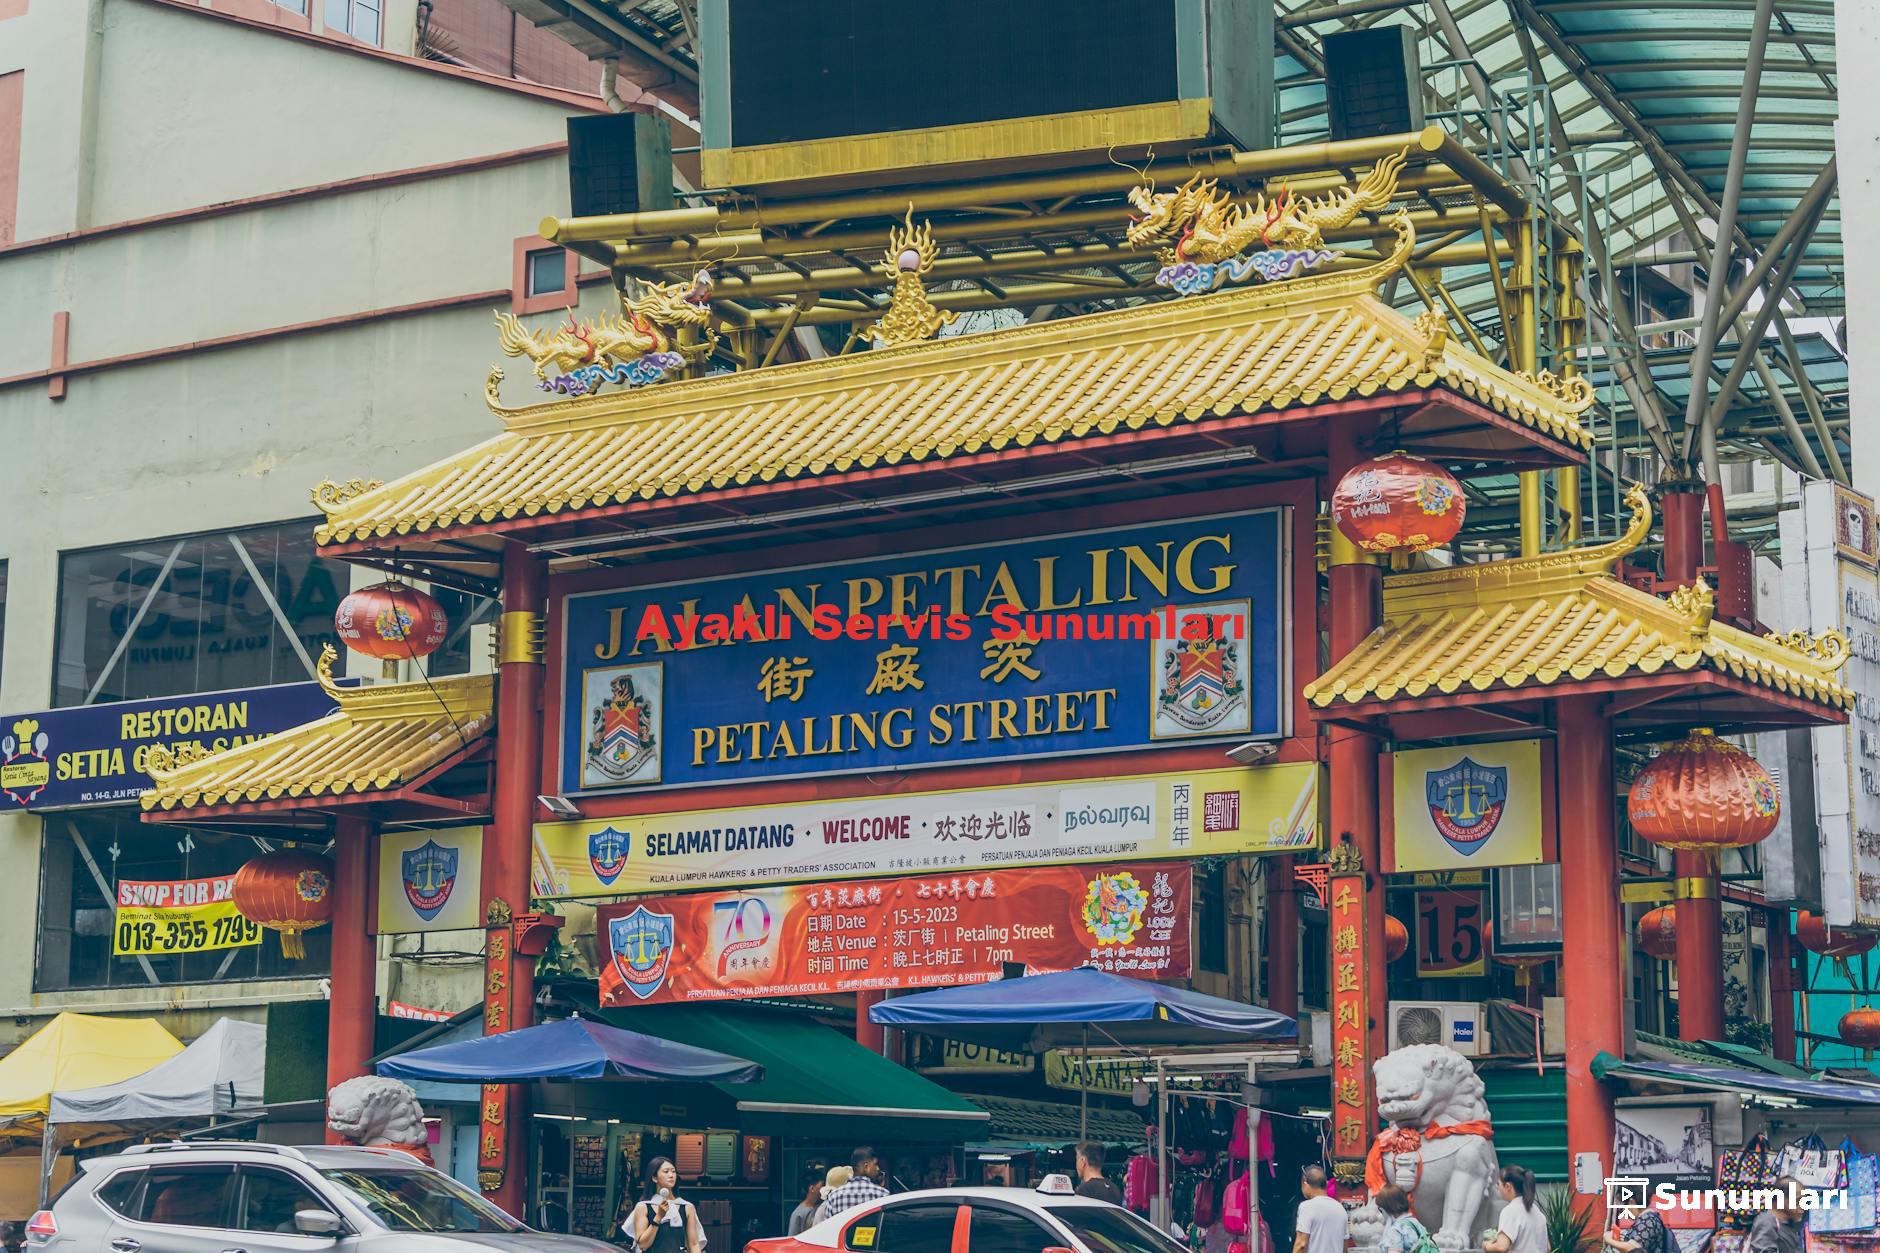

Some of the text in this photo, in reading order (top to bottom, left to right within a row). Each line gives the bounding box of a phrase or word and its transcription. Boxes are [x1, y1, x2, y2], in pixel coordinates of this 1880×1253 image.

[843, 533, 1239, 632] PETALING
[121, 701, 248, 740] RESTORAN
[690, 687, 1117, 767] PETALING STREET
[56, 747, 126, 781] SETIA
[81, 792, 94, 800] NO.
[112, 789, 126, 798] JLN
[933, 809, 1033, 842] 欢迎光临
[1064, 803, 1150, 833] நல்வரவு
[1172, 784, 1191, 847] 丙申年
[646, 828, 721, 858] SELAMAT
[725, 824, 795, 851] DATANG
[822, 815, 911, 845] WELCOME
[981, 842, 1138, 862] PERSATUAN PENJAJA DAN PENIAGA KECIL KUALA LUMPUR
[650, 873, 674, 883] KUALA
[676, 871, 707, 882] LUMPUR
[750, 868, 756, 878] &
[758, 865, 782, 876] PETTY
[784, 863, 822, 874] TRADERS'
[823, 860, 876, 872] ASSOCIATION
[121, 883, 170, 906] SHOP
[173, 882, 208, 905] FOR
[119, 914, 259, 951] 013-355 1799
[714, 897, 771, 942] 70
[807, 915, 832, 932] 日期
[836, 914, 866, 930] Date
[892, 907, 958, 926] 15-5-2023
[1420, 904, 1482, 964] 15
[723, 940, 760, 958] ANNIVERSARY
[807, 935, 834, 953] 地点
[836, 934, 877, 951] Venue
[893, 928, 935, 947] 茨厂街
[956, 925, 1009, 943] Petaling
[1012, 923, 1054, 940] Street
[807, 956, 834, 974] 时间
[837, 956, 869, 971] Time
[892, 947, 964, 968] 晚上七时正
[986, 947, 1013, 968] 7pm
[688, 982, 831, 999] PERSATUAN PENJAJA DAN PENIAGA KECIL K.L.
[908, 977, 921, 985] K.L.
[922, 973, 956, 983] HAWKERS'
[958, 974, 963, 982] &
[964, 973, 986, 982] PETTY
[1454, 1028, 1473, 1036] Haier
[1690, 1174, 1711, 1182] Petaling
